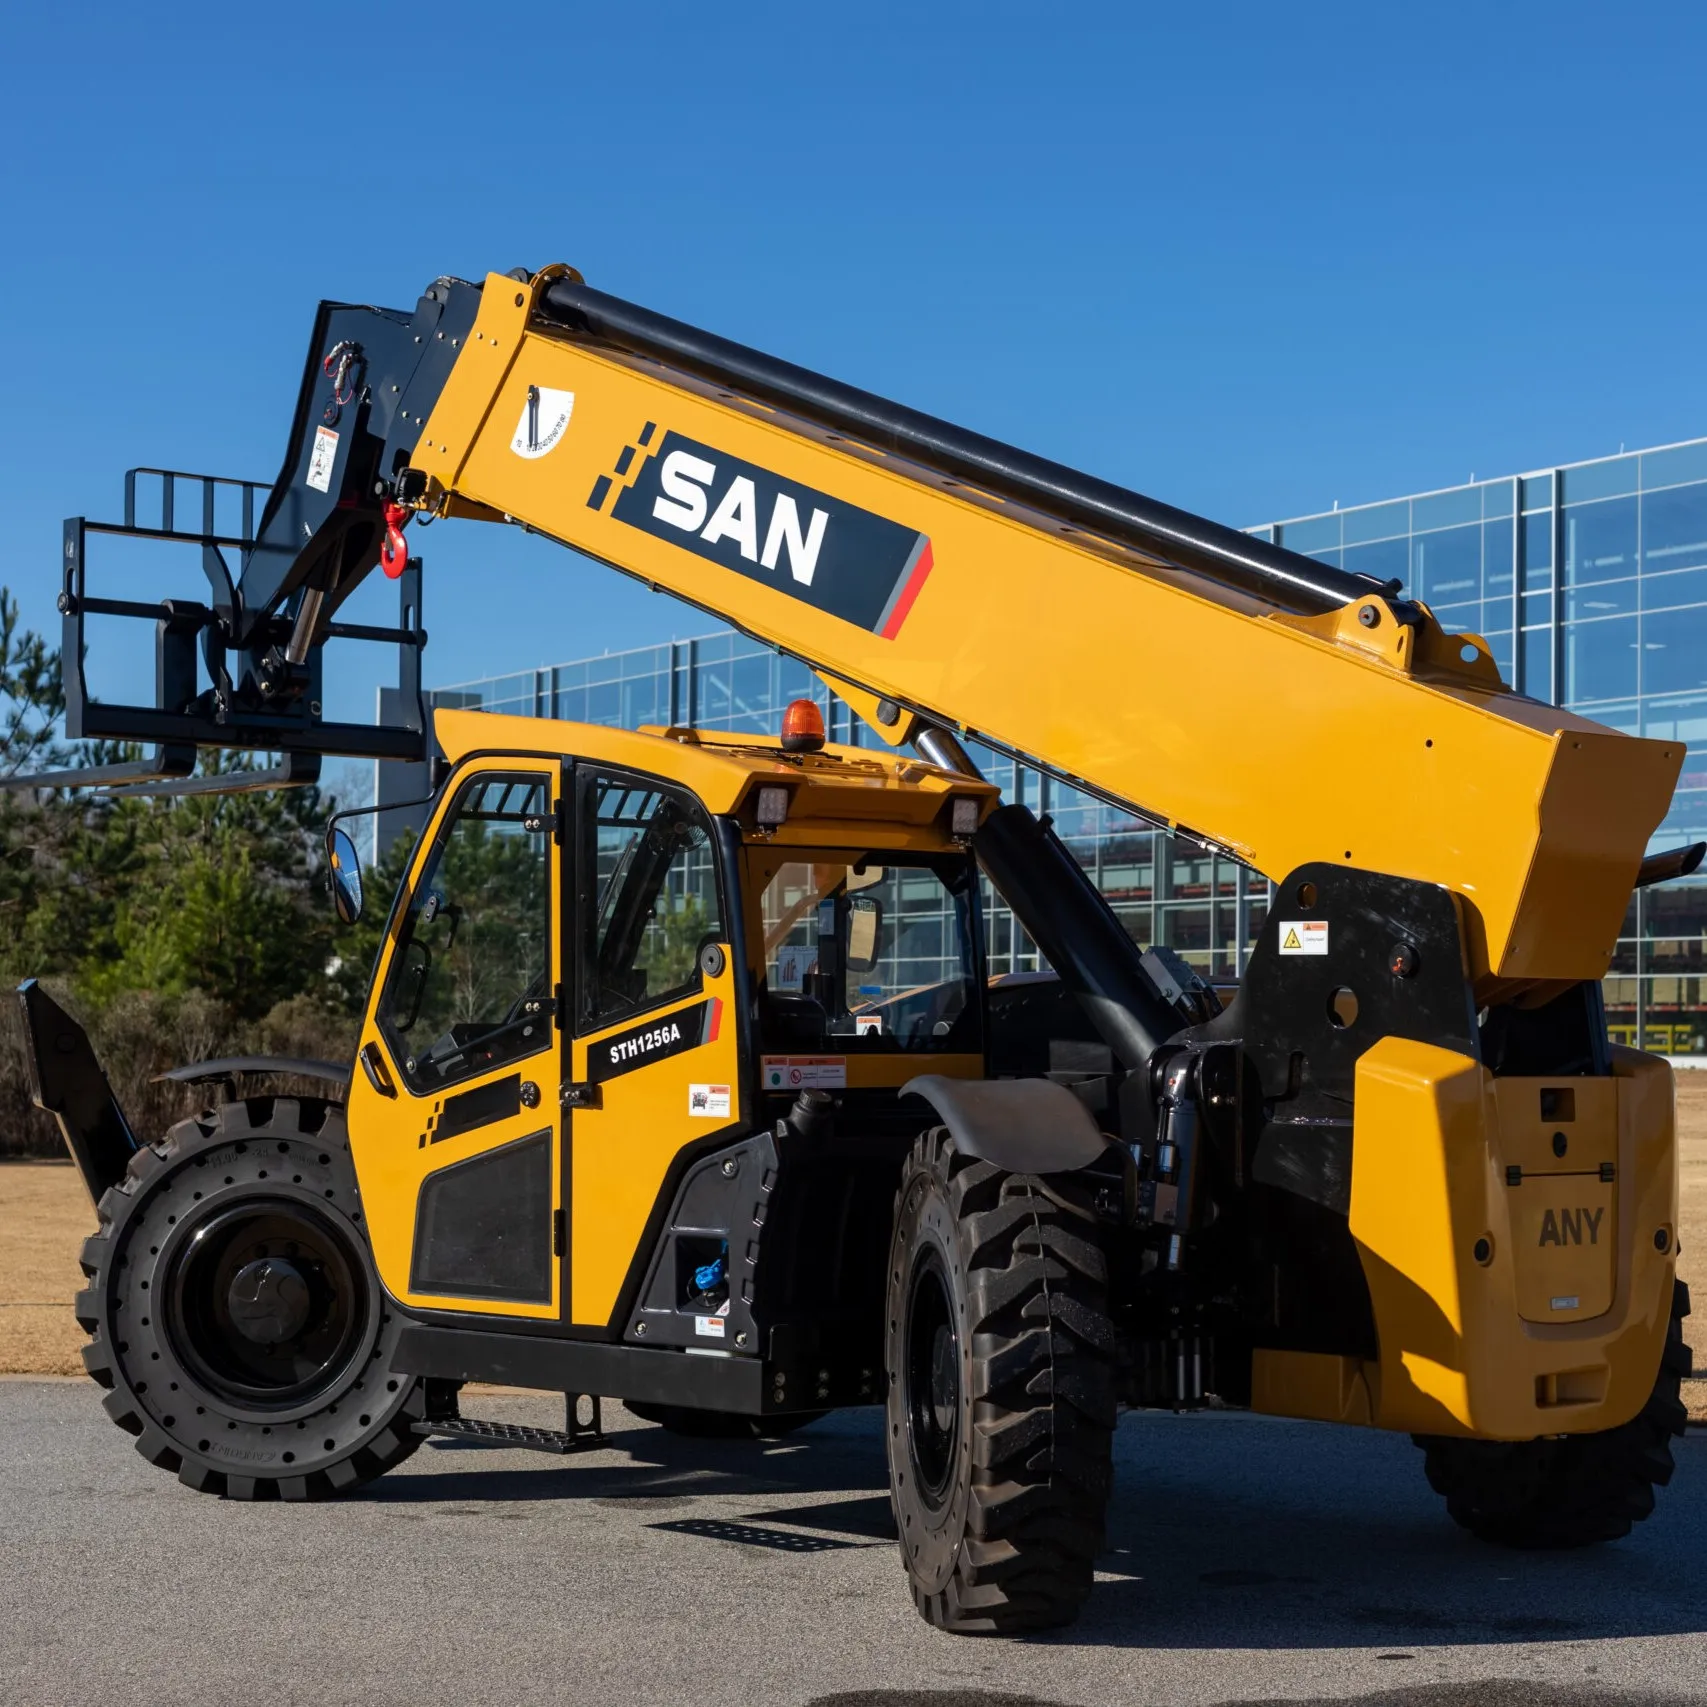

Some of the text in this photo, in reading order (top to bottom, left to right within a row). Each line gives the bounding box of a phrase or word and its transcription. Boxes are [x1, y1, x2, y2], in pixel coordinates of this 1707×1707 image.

[652, 450, 829, 586] SAN
[610, 1023, 681, 1064] STH1256A
[1538, 1207, 1605, 1247] ANY
